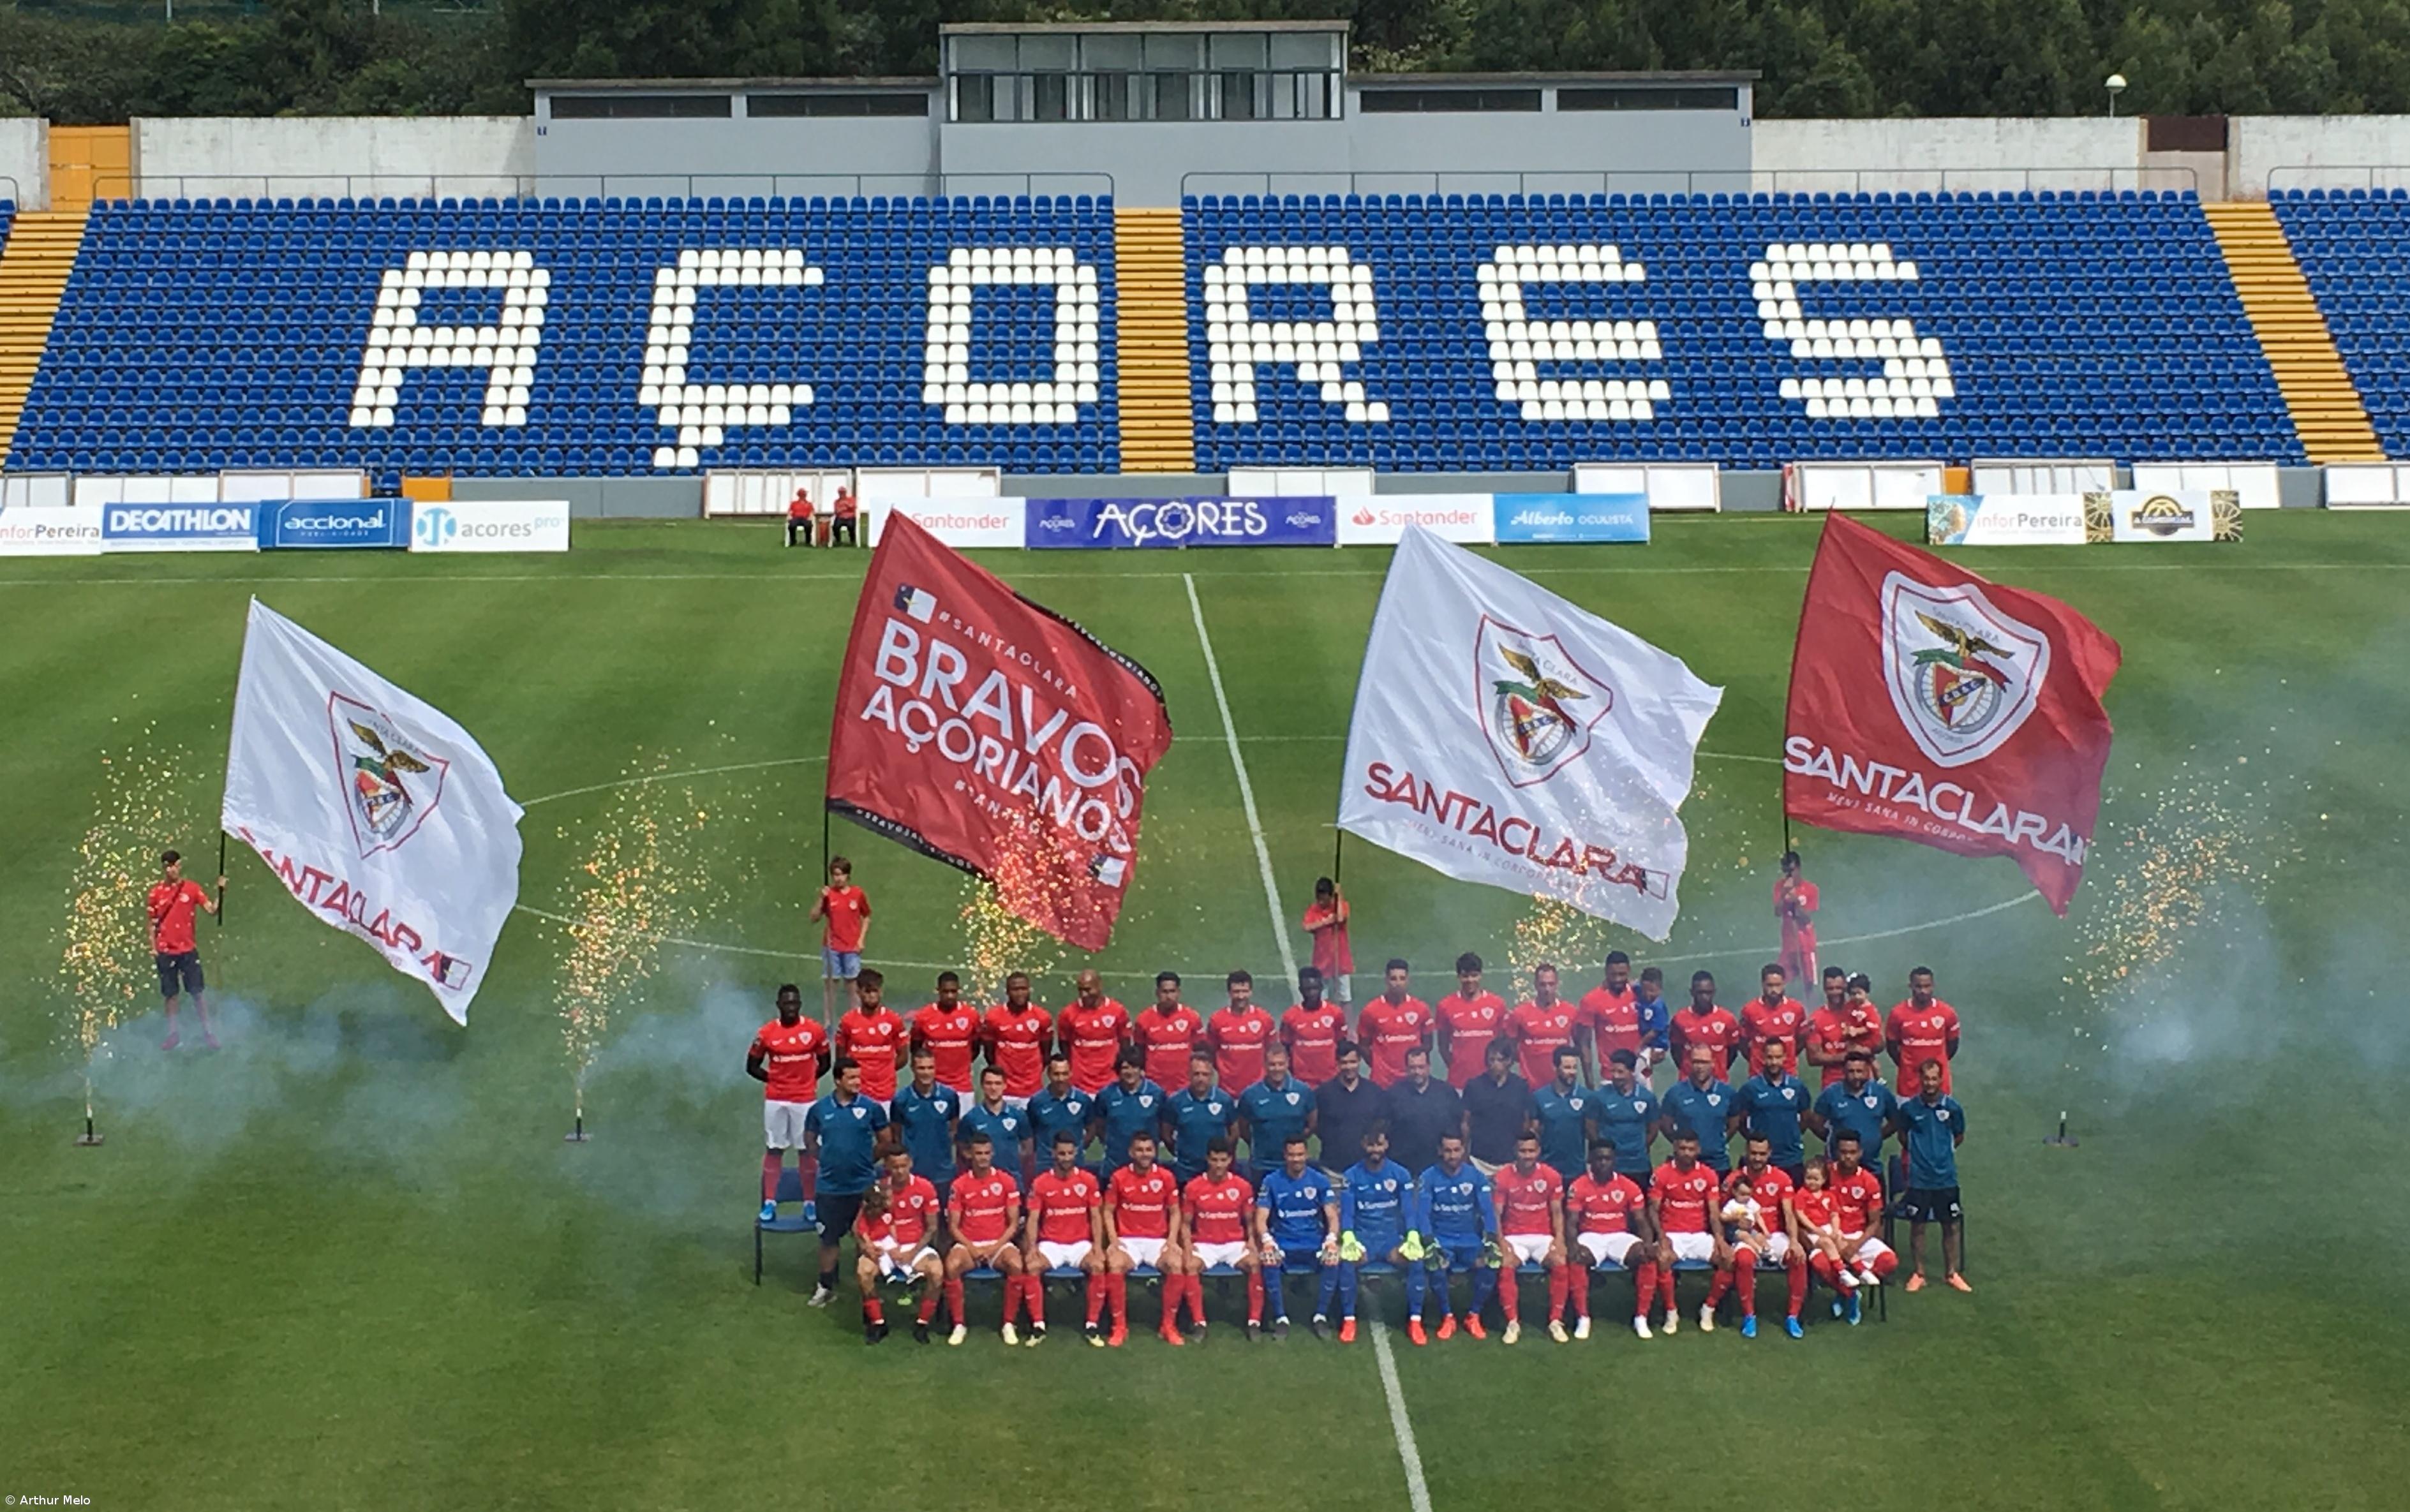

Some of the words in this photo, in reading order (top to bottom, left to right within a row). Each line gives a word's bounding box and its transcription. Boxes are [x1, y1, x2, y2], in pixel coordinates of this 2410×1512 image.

[350, 243, 1954, 467] AÇORES
[110, 509, 251, 532] DECATHLON
[912, 512, 1009, 529] Santander
[1093, 501, 1267, 547] AÇORES
[1379, 509, 1478, 526] Santander
[1510, 510, 1574, 526] Alberto
[0, 524, 100, 539] nforPereira
[461, 523, 532, 537] acores
[939, 611, 1078, 699] #SANTACLARA
[875, 616, 1142, 819] BRAVOS
[1784, 736, 2071, 866] SANTACLARA
[1864, 803, 1899, 820] SANA
[1364, 762, 1644, 895] SANTACLARA
